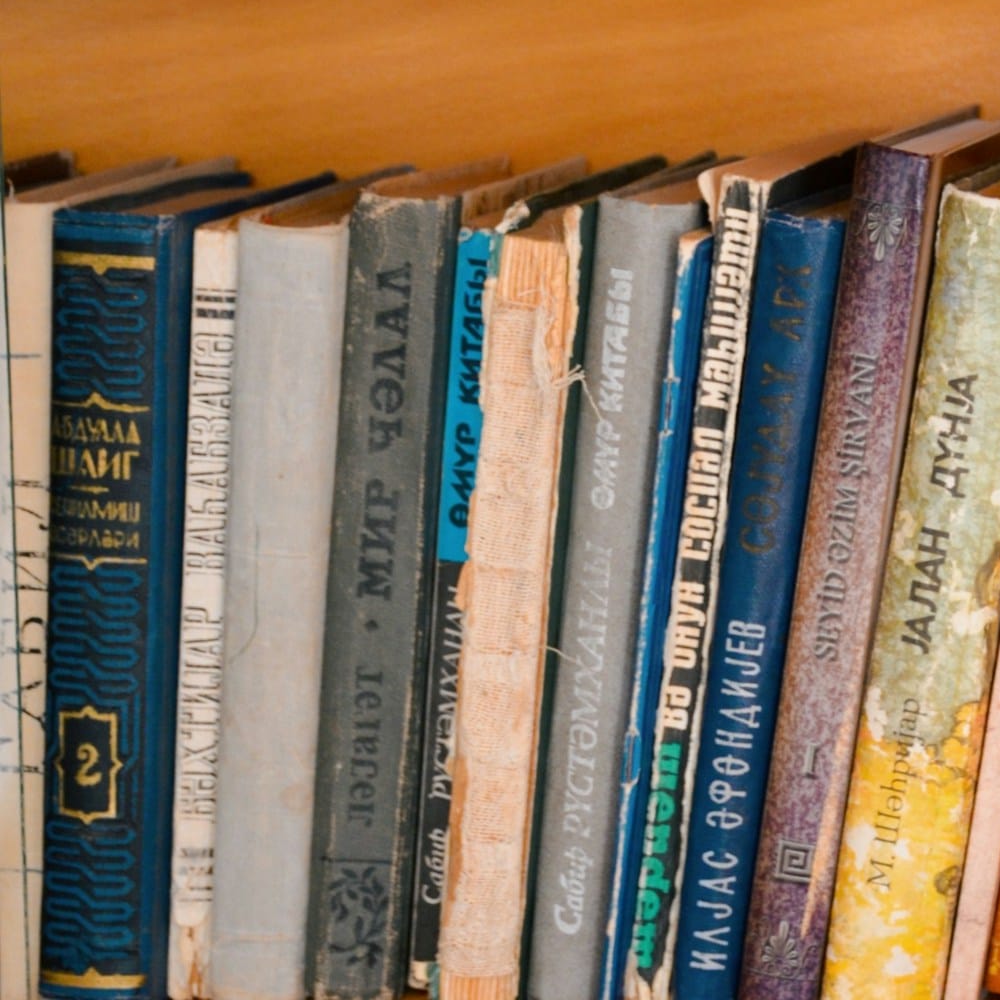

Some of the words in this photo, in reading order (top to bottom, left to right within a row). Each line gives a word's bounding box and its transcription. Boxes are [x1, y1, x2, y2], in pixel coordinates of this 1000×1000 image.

[50, 448, 140, 480] ШАИГ
[677, 425, 724, 562] сосиал
[51, 526, 140, 549] СӘРЛӘРИ
[356, 478, 400, 602] МИР
[421, 827, 446, 906] Сабир
[457, 257, 488, 406] КИТАБЫ
[553, 846, 596, 936] Сабир
[598, 267, 634, 412] КИТАБЫ
[668, 581, 706, 669] онун
[75, 742, 102, 787] 2
[707, 619, 767, 831] ӘФӘНДИЈЕВ
[866, 855, 896, 891] М.
[899, 527, 951, 656] ЈАЛАН
[688, 848, 740, 972] ИЛЈАС
